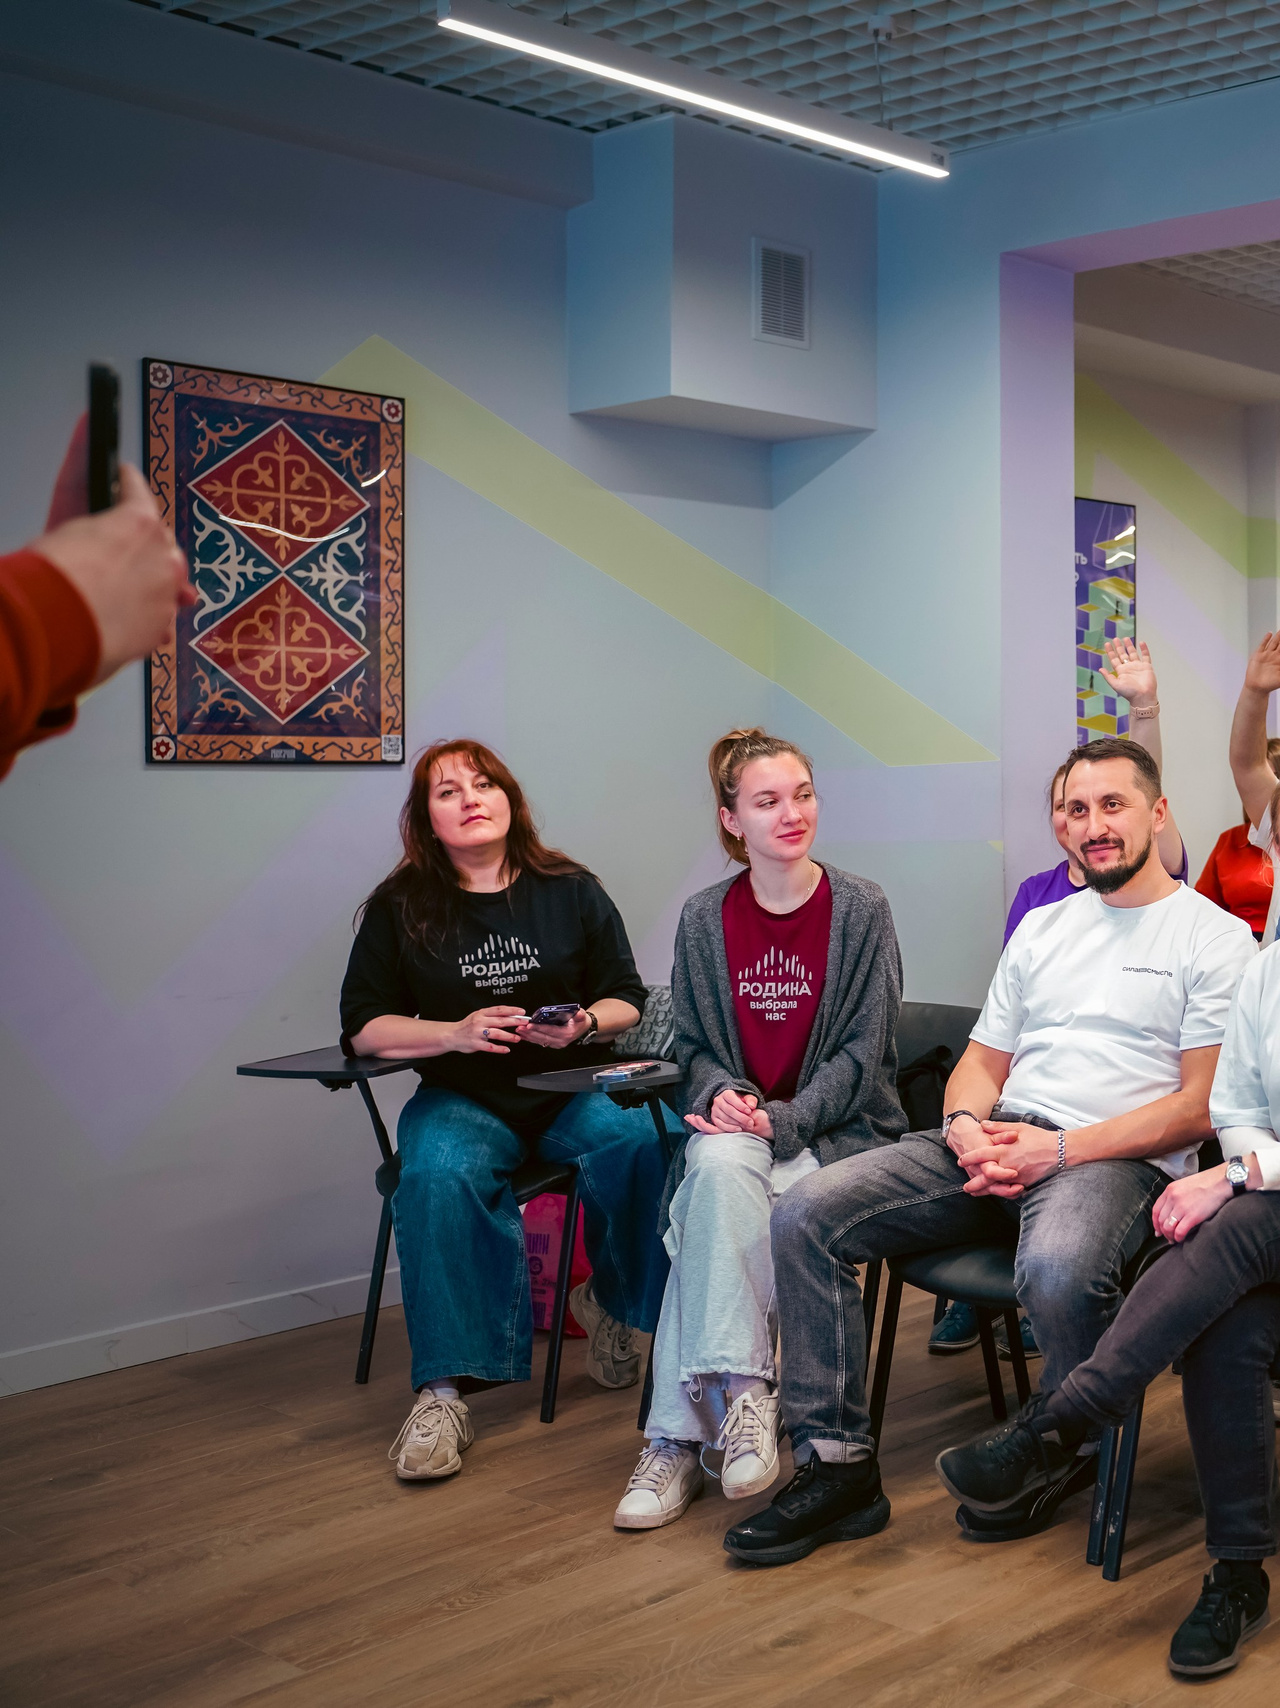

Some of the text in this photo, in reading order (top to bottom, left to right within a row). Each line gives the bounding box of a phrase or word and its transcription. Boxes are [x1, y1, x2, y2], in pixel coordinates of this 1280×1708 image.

[461, 956, 541, 978] РОДИНА
[475, 974, 529, 988] выбрала
[492, 986, 514, 996] нас
[738, 981, 813, 999] РОДИНА
[749, 999, 798, 1012] выбрала
[765, 1012, 787, 1021] нас
